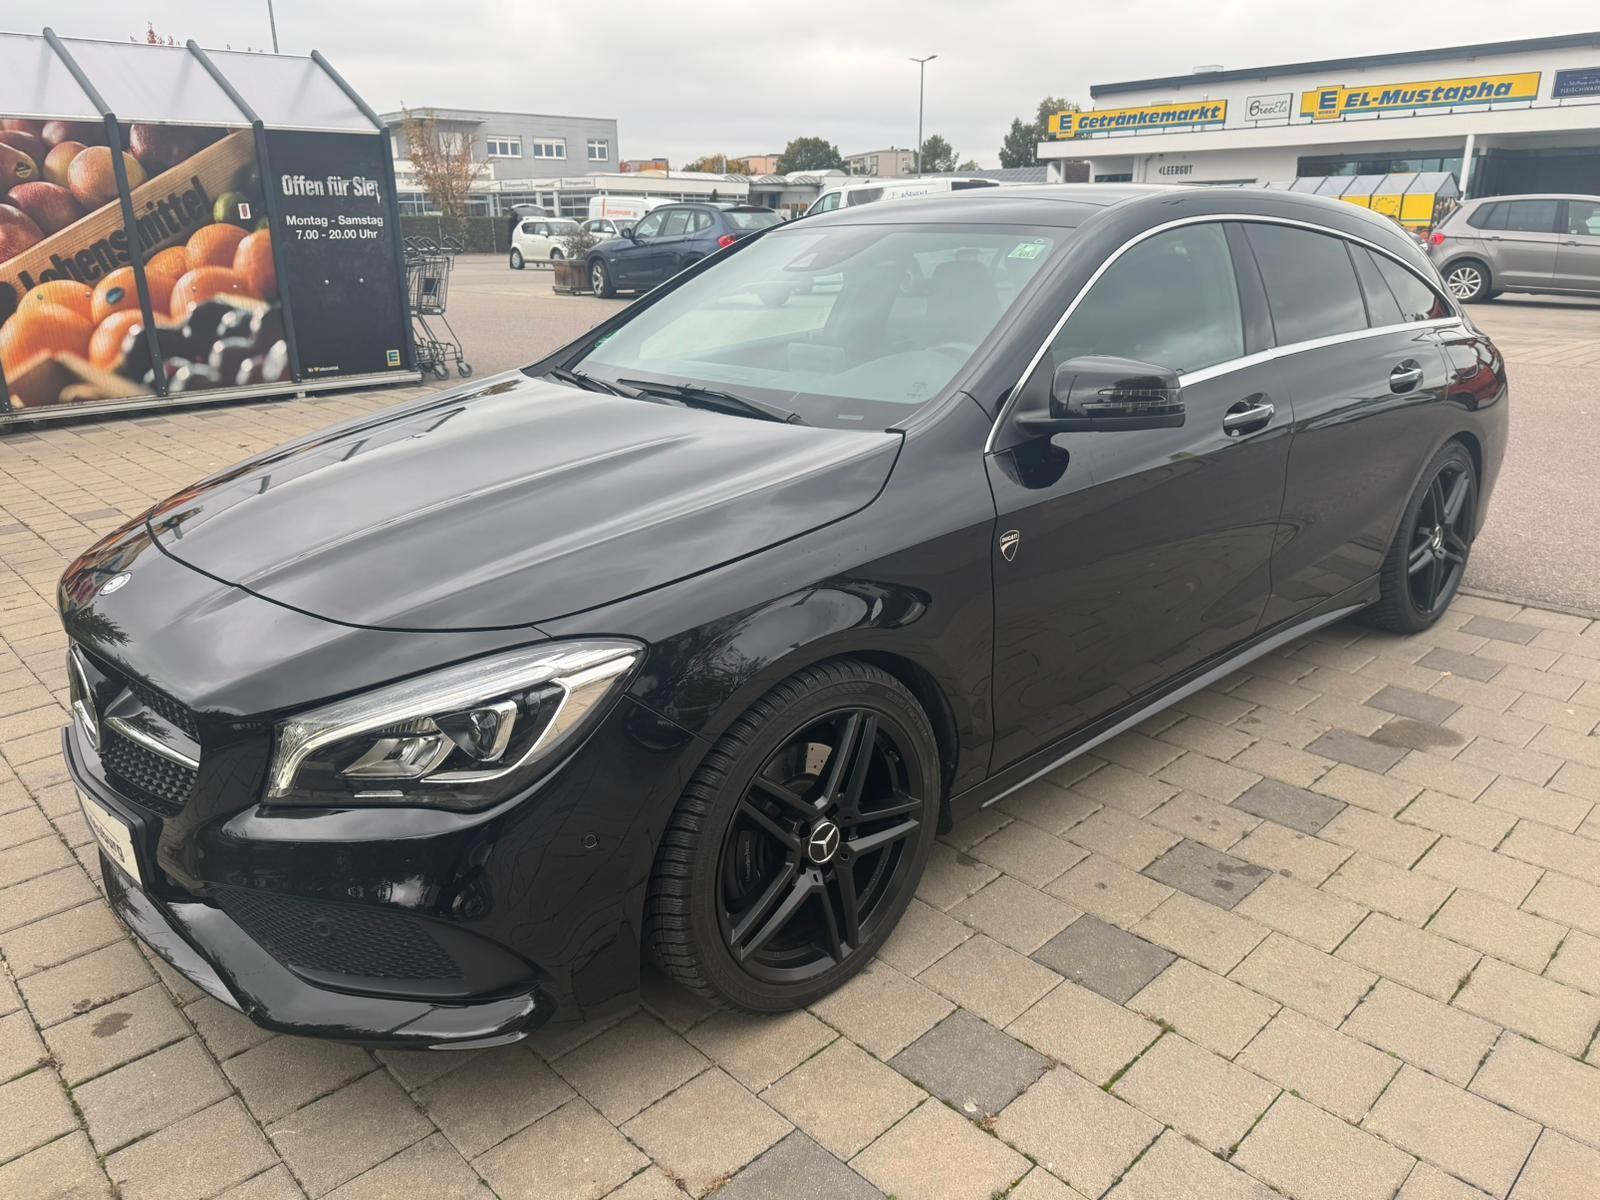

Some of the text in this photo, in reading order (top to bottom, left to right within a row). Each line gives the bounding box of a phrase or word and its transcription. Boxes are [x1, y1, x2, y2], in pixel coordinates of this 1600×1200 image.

[1344, 81, 1513, 108] EL-Mustapha
[1078, 104, 1221, 130] Getränkemarkt
[1162, 164, 1194, 176] LEERGUT
[281, 174, 325, 196] Offen
[327, 175, 350, 196] für
[285, 215, 328, 228] Montag
[337, 214, 384, 227] Samstag
[295, 229, 319, 240] 7.00
[328, 229, 357, 240] 20.00
[359, 229, 378, 239] Uhr
